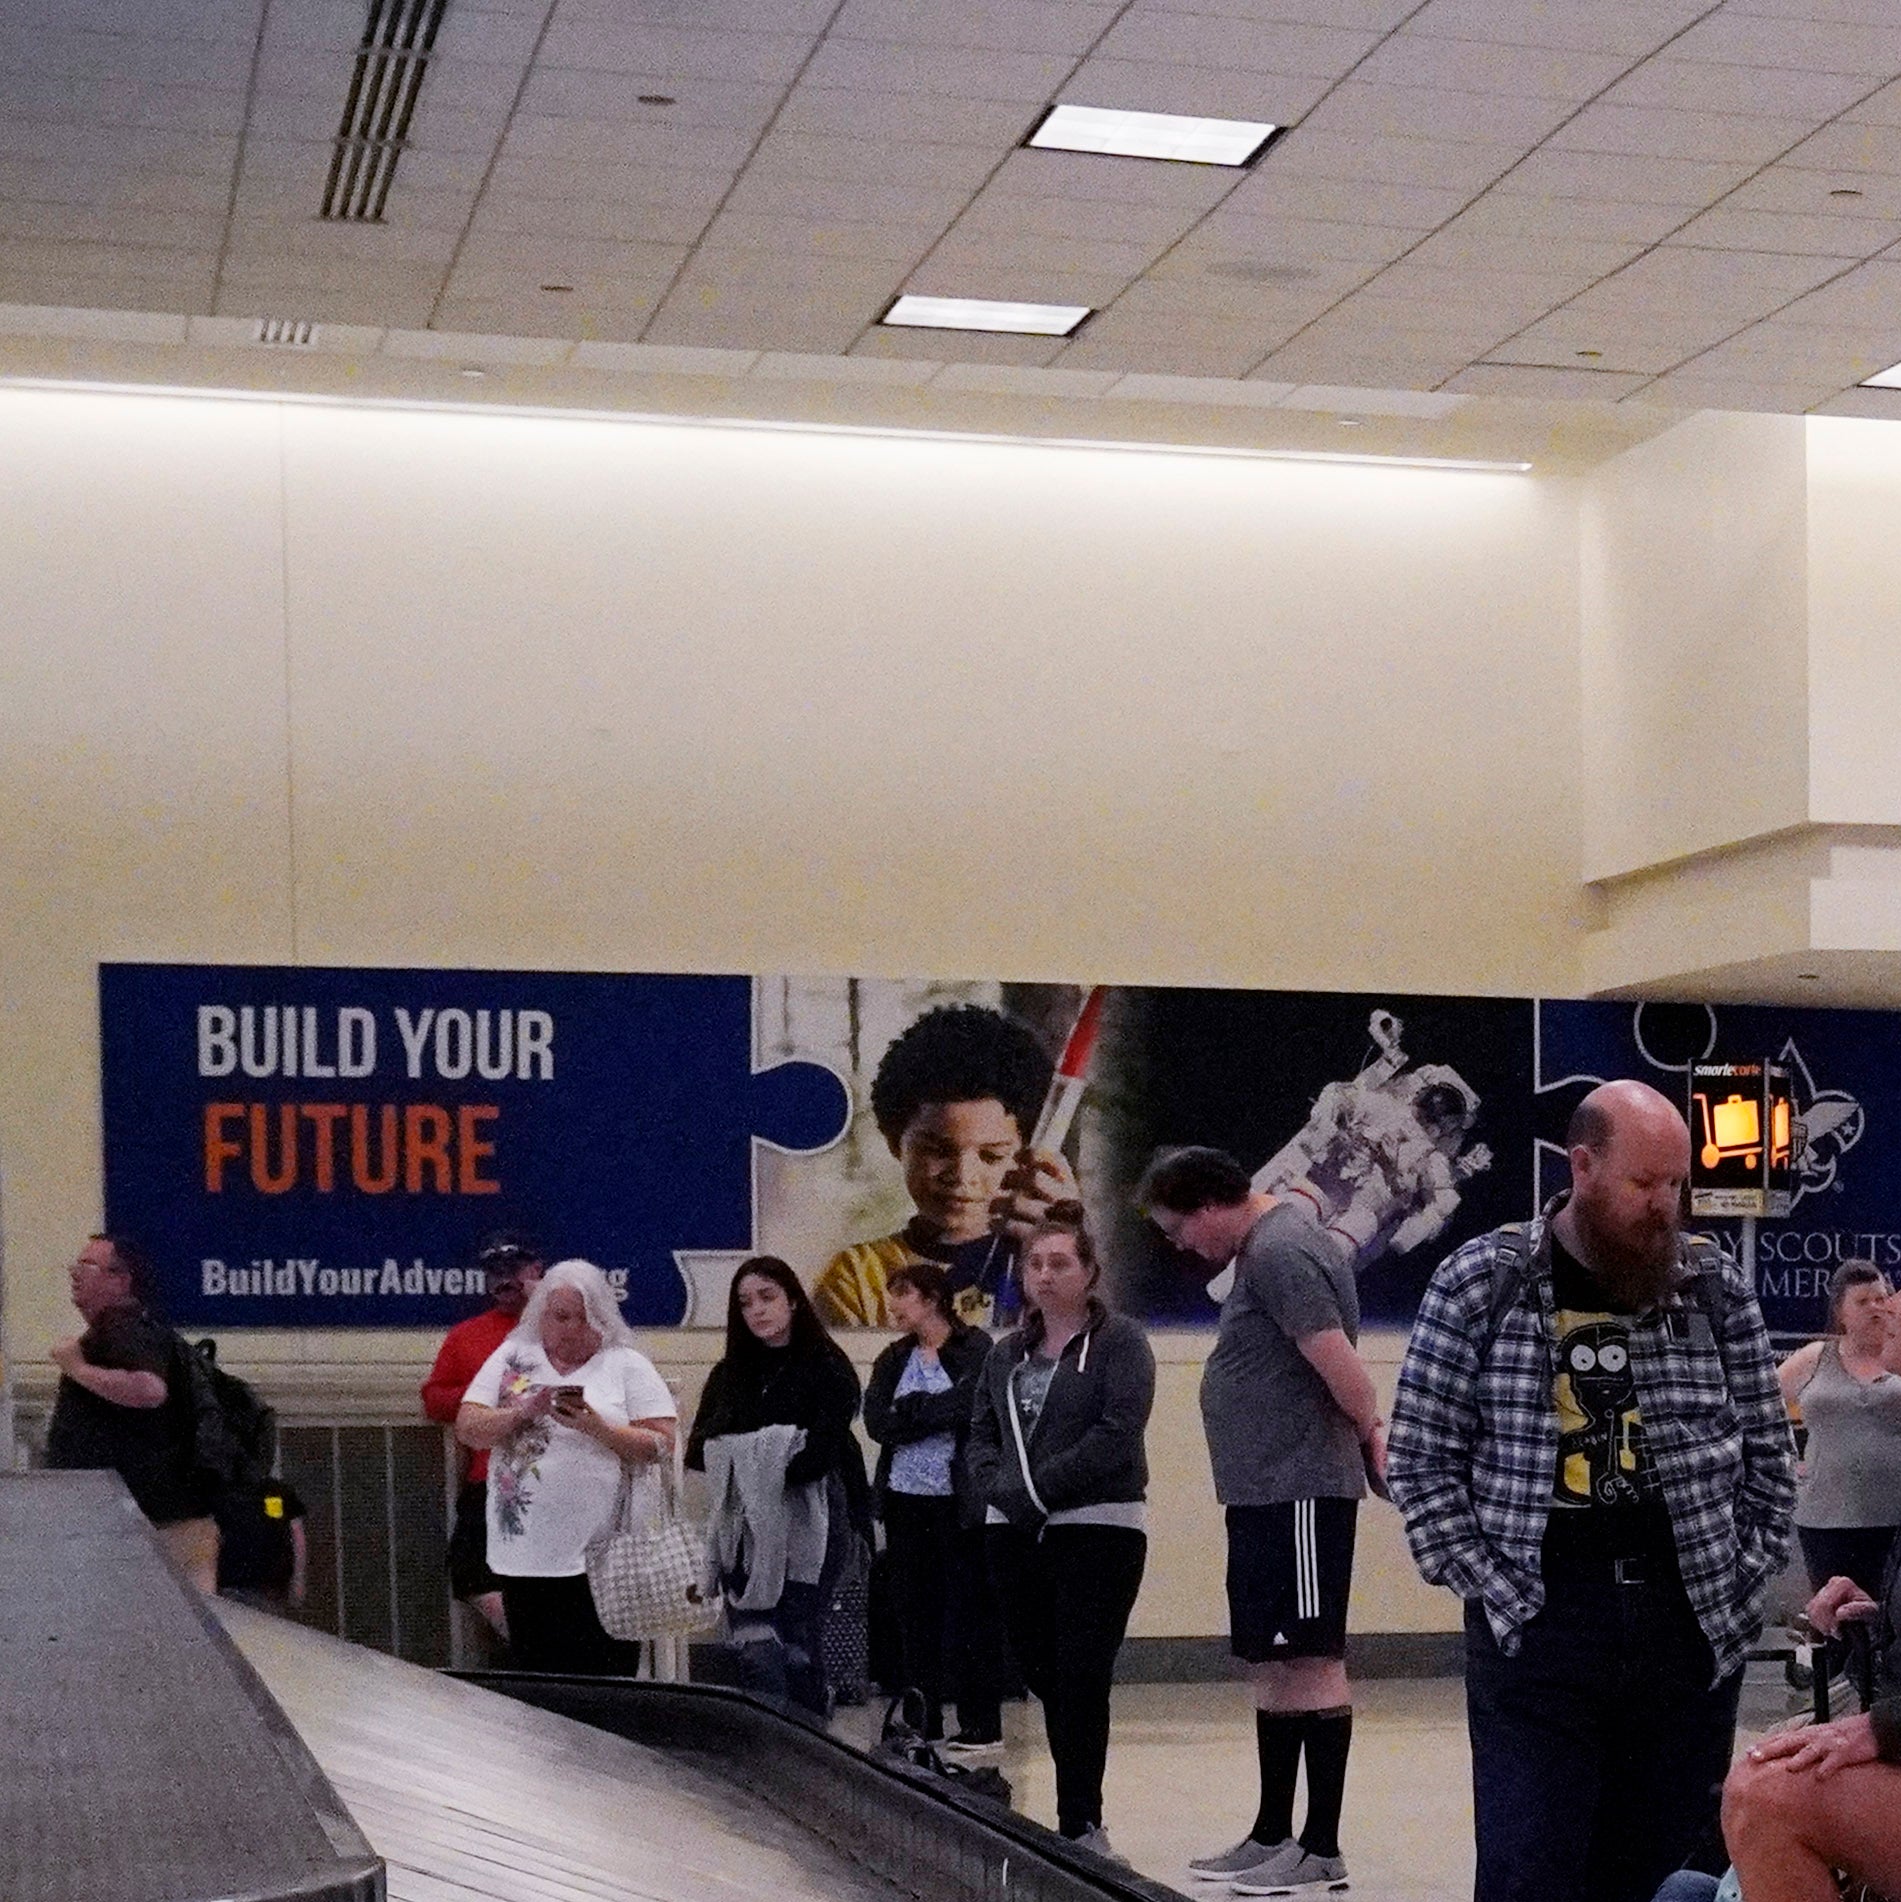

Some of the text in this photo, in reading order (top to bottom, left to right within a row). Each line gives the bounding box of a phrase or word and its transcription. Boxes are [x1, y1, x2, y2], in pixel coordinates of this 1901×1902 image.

[197, 1004, 556, 1081] BUILD YOUR
[204, 1102, 501, 1195] FUTURE
[1760, 1231, 1901, 1265] SCOUTS
